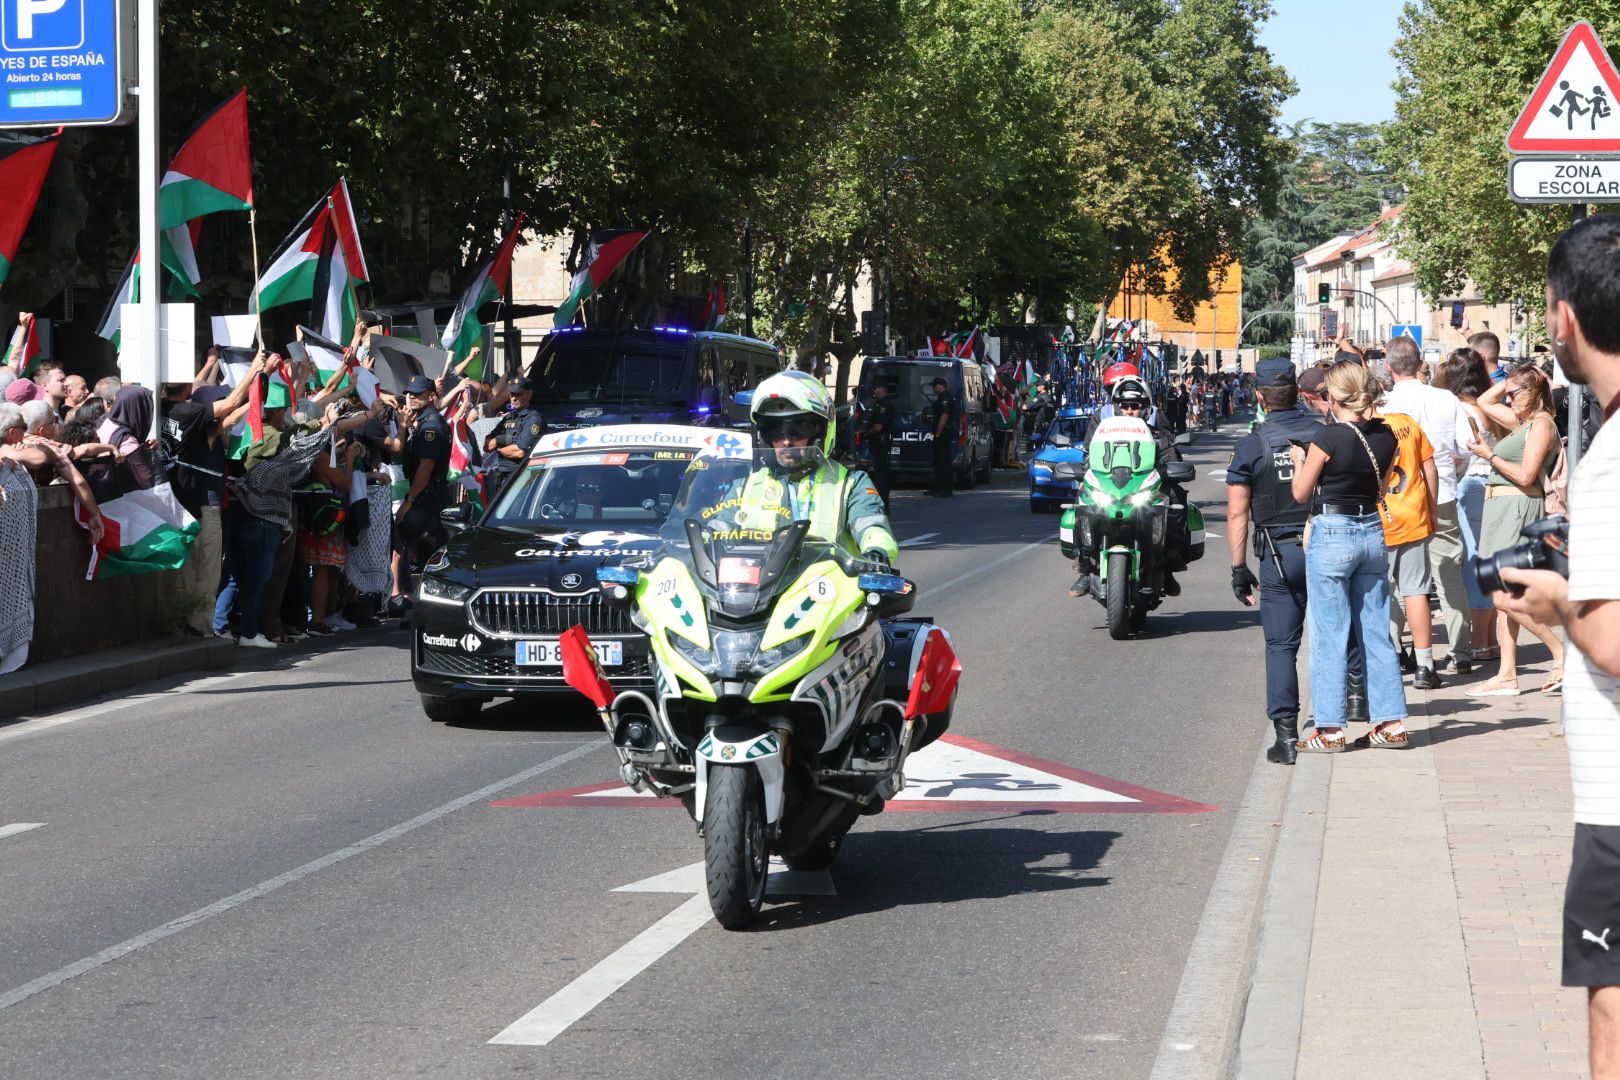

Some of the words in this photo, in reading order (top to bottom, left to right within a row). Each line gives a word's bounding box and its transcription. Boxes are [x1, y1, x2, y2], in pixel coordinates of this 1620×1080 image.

[29, 56, 47, 68] DE
[52, 52, 105, 67] ESPAÑA
[6, 74, 40, 83] Abierto
[42, 73, 54, 82] 24
[55, 72, 82, 81] horas
[1555, 165, 1602, 178] ZONA
[1538, 181, 1619, 194] ESCOLAR
[890, 431, 935, 442] LICIA
[1099, 426, 1147, 435] Kawasaki
[600, 431, 693, 444] Carrefour
[515, 548, 653, 557] Carrefour
[657, 578, 677, 596] 201
[818, 581, 826, 595] 6
[423, 632, 458, 648] Carrefour
